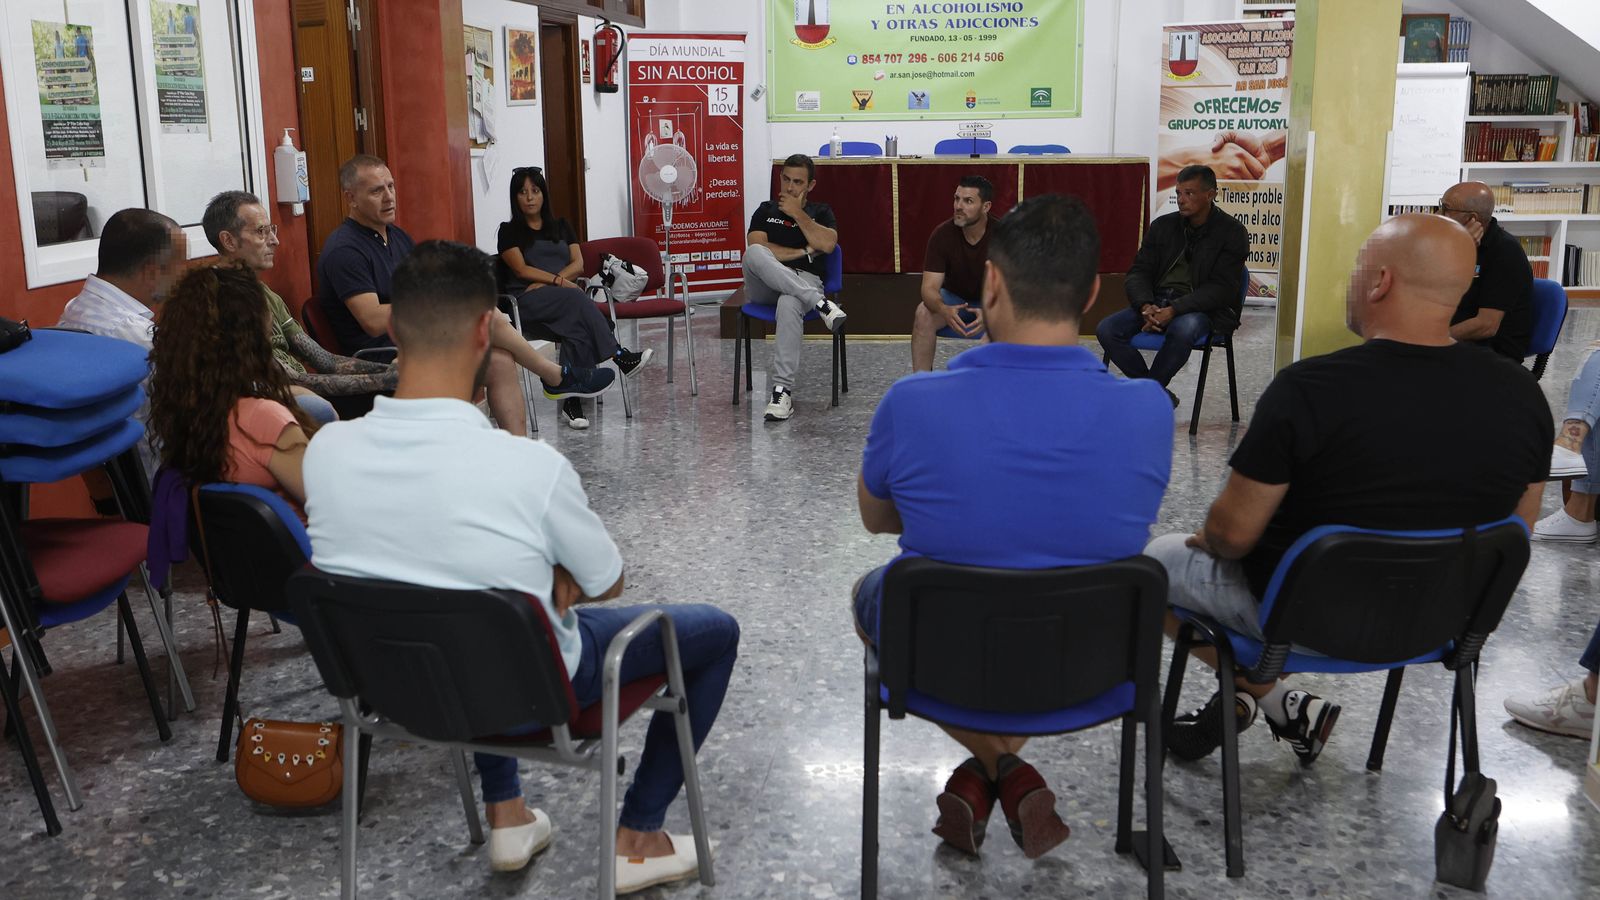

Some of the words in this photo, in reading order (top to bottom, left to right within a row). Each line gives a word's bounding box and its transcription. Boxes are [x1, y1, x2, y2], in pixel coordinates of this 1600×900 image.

[886, 4, 905, 15] EN
[912, 1, 1024, 15] ALCOHOLISMO
[871, 19, 880, 30] Y
[886, 18, 938, 30] OTRAS
[945, 16, 1039, 29] ADICCIONES
[910, 35, 946, 43] FUNDADO,
[948, 34, 958, 42] 13
[1201, 28, 1250, 44] ASOCIACIÓN
[1250, 30, 1262, 42] DE
[649, 43, 669, 57] DÍA
[672, 46, 725, 57] MUNDIAL
[861, 53, 881, 65] 854
[884, 53, 903, 64] 707
[908, 53, 927, 64] 296
[937, 52, 958, 63] 606
[961, 52, 981, 63] 214
[984, 51, 1004, 62] 506
[637, 65, 662, 80] SIN
[667, 65, 737, 80] ALCOHOL
[1239, 61, 1256, 74] SAN
[1256, 59, 1277, 74] JOSÉ
[889, 70, 976, 80] ar.san.jose@hotmail.com
[715, 87, 728, 102] 15
[711, 103, 738, 114] nov.
[1194, 97, 1281, 113] OFRECEMOS
[1167, 118, 1216, 130] GRUPOS
[1218, 118, 1234, 130] DE
[705, 142, 714, 150] La
[716, 142, 730, 150] vida
[707, 154, 737, 163] libertad.
[709, 178, 737, 189] ¿Deseas
[1222, 187, 1250, 203] Tienes
[1252, 187, 1283, 208] proble
[1251, 209, 1260, 225] el
[1262, 209, 1281, 226] alco
[1260, 232, 1266, 245] a
[1268, 233, 1279, 245] ve
